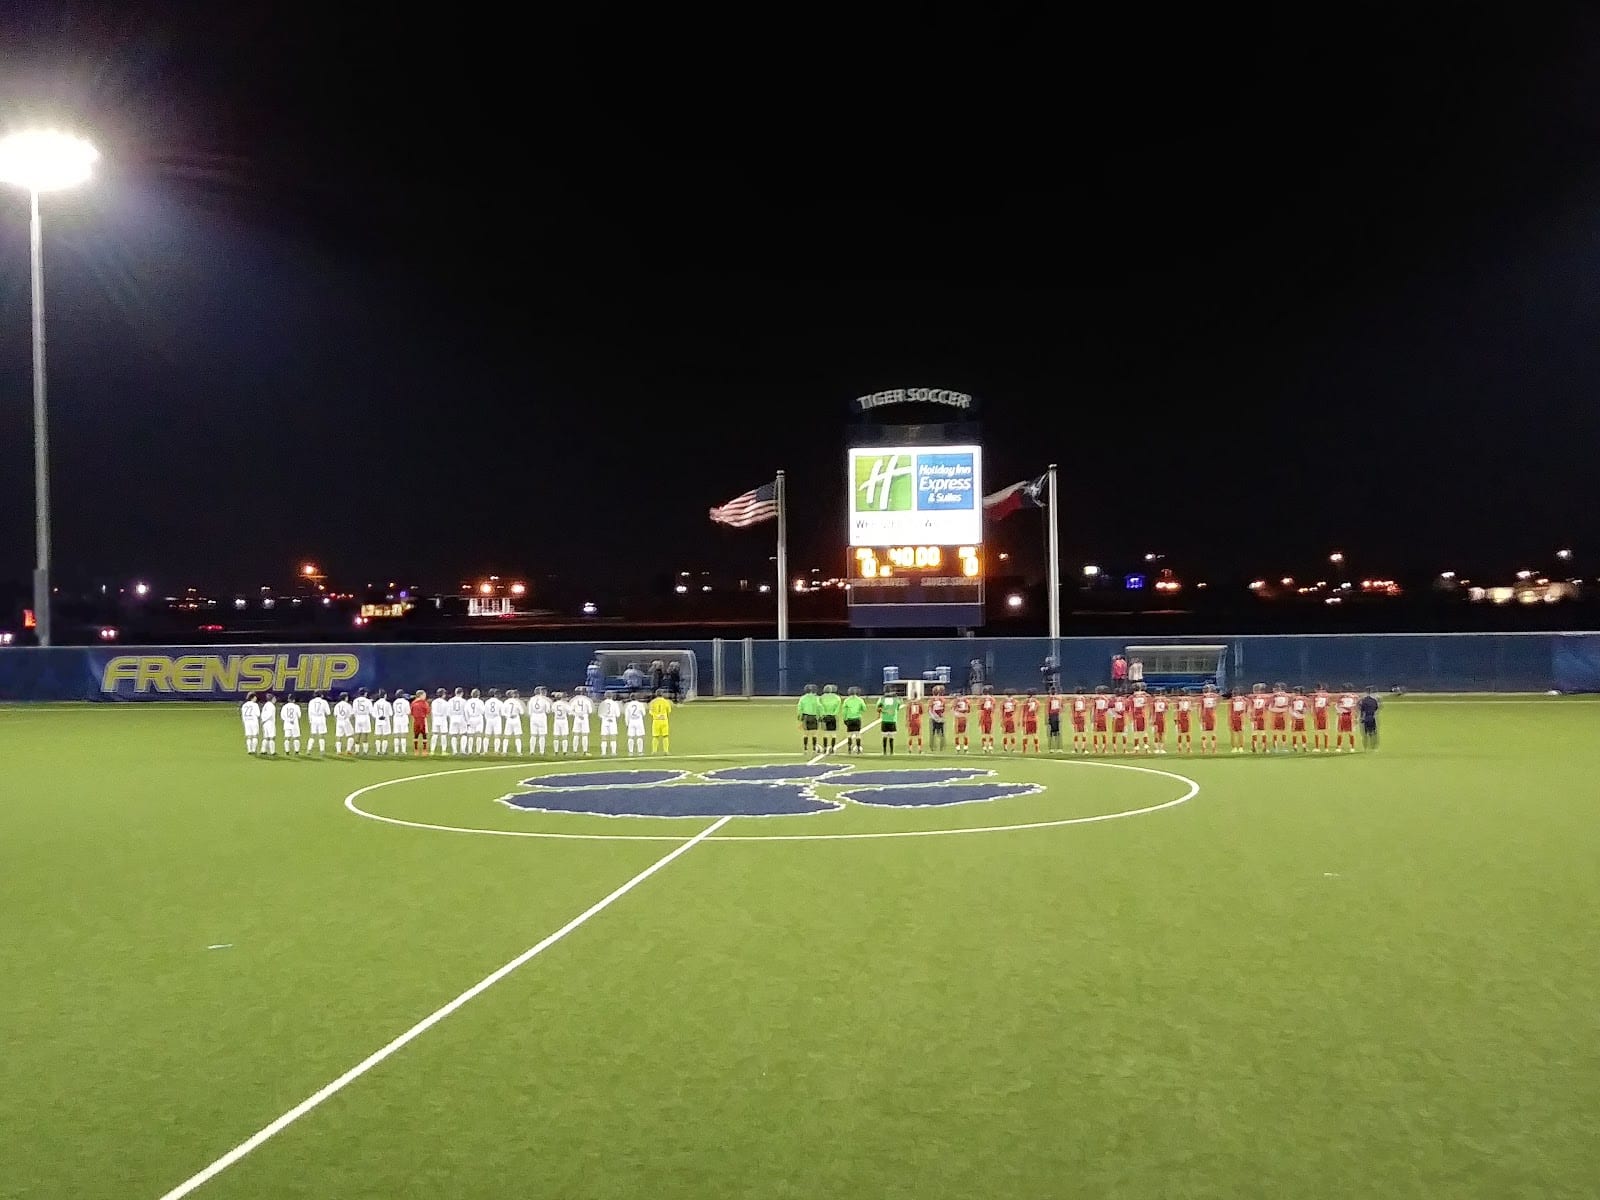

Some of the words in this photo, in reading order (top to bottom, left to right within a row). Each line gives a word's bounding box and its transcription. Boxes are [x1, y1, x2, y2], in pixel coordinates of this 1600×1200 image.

[856, 388, 906, 409] TIGER
[906, 387, 972, 408] SOCCER
[919, 463, 956, 477] Holiday
[955, 463, 972, 474] Inn
[919, 476, 972, 493] Express
[936, 492, 963, 503] Suites
[101, 653, 360, 693] FRENSHIP
